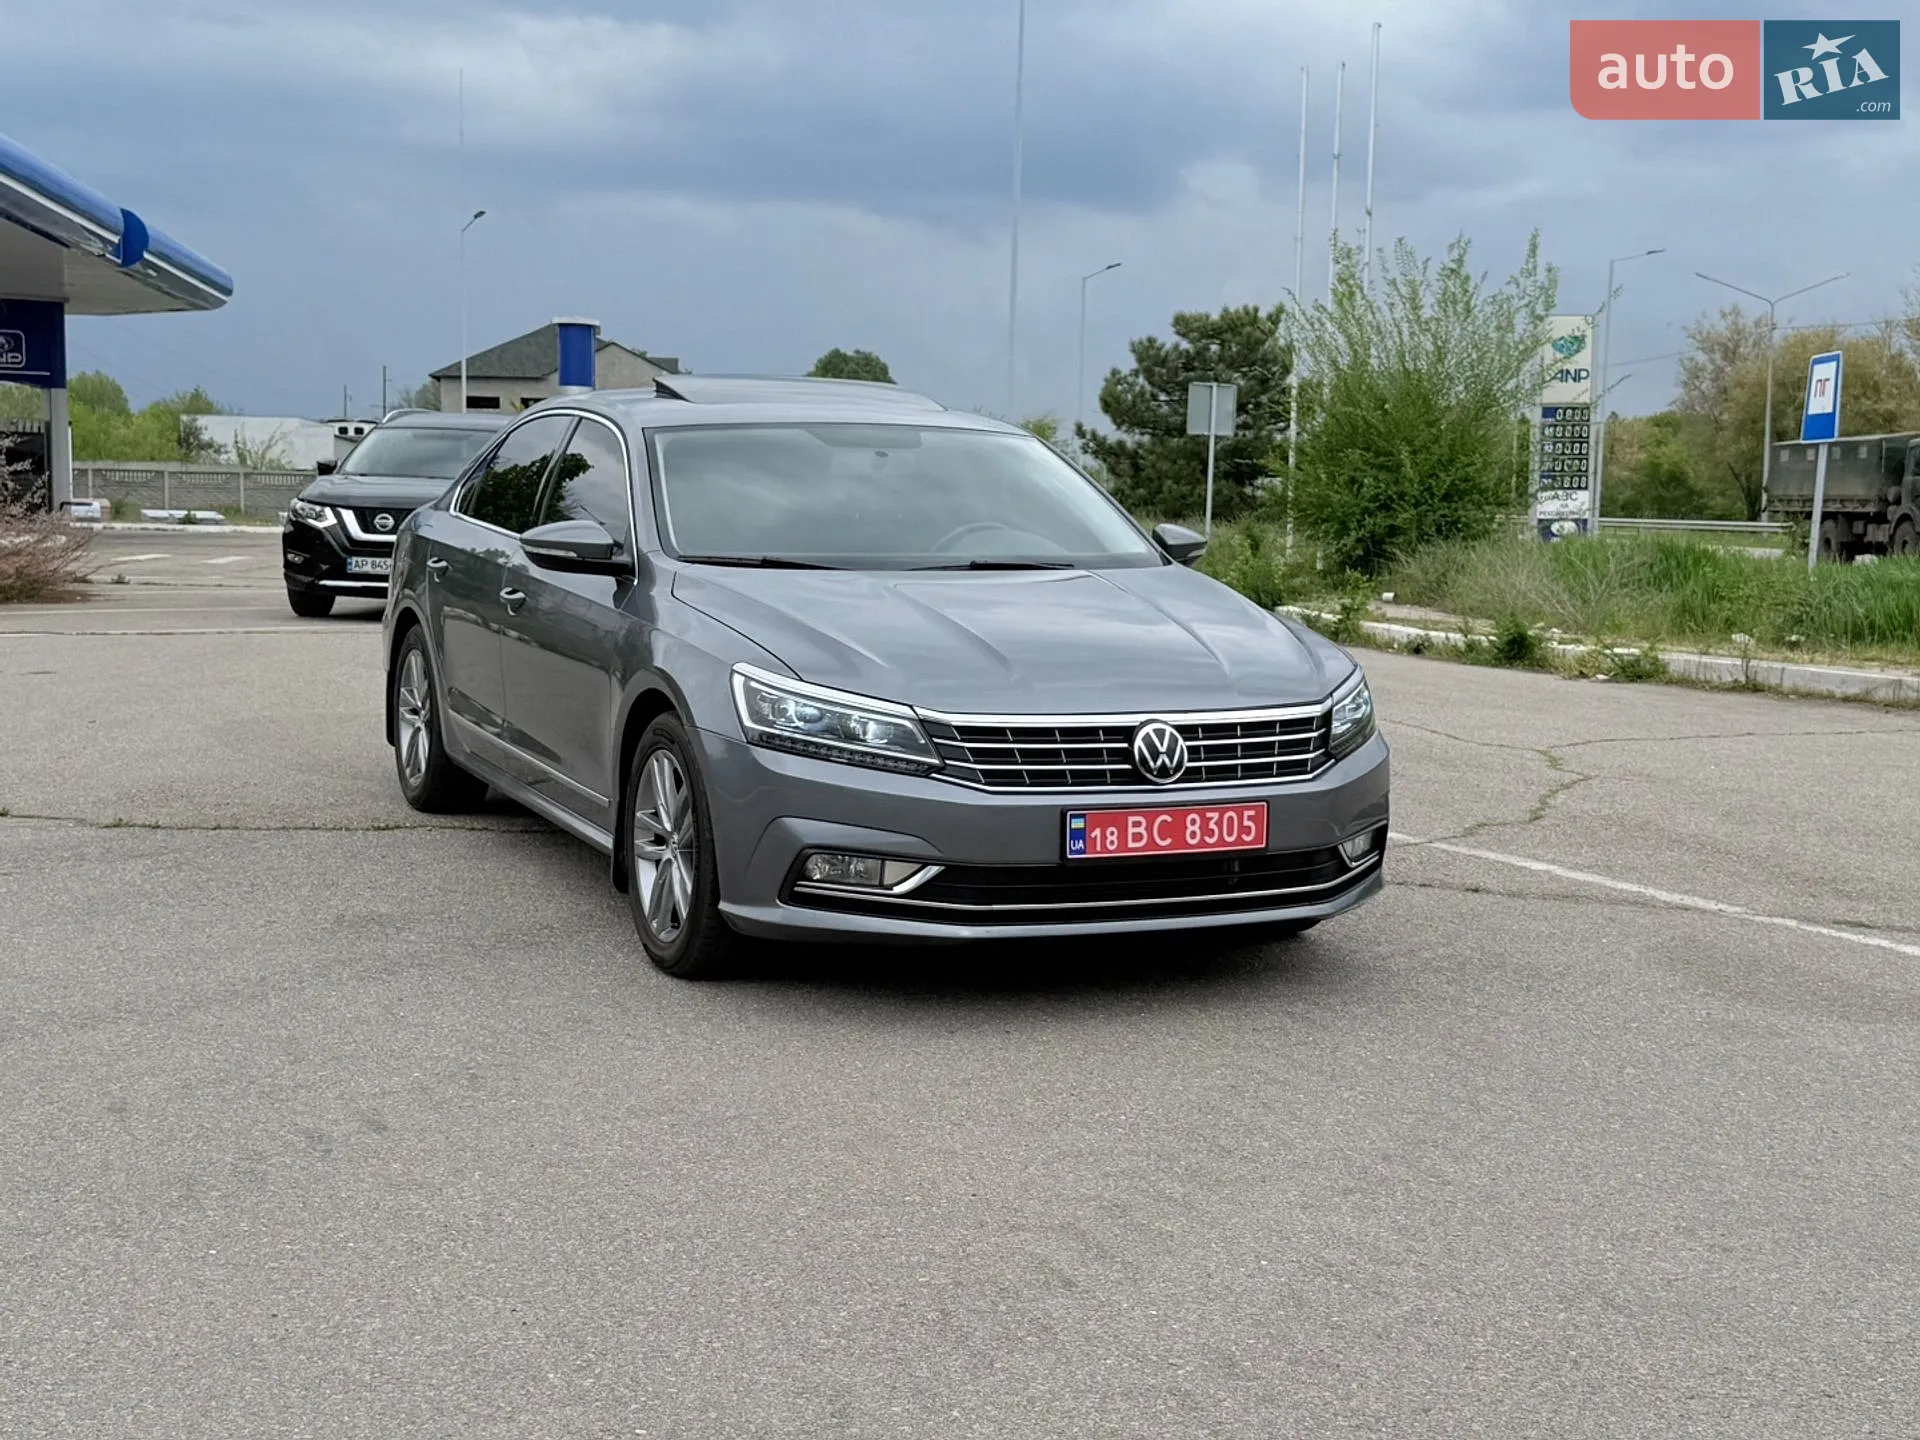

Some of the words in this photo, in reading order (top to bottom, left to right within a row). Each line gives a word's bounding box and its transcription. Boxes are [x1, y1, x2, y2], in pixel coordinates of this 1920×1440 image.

[371, 560, 392, 570] 845
[1090, 826, 1118, 851] 18
[1127, 814, 1173, 848] BC
[1185, 810, 1256, 845] 8305
[1070, 839, 1084, 850] UA
